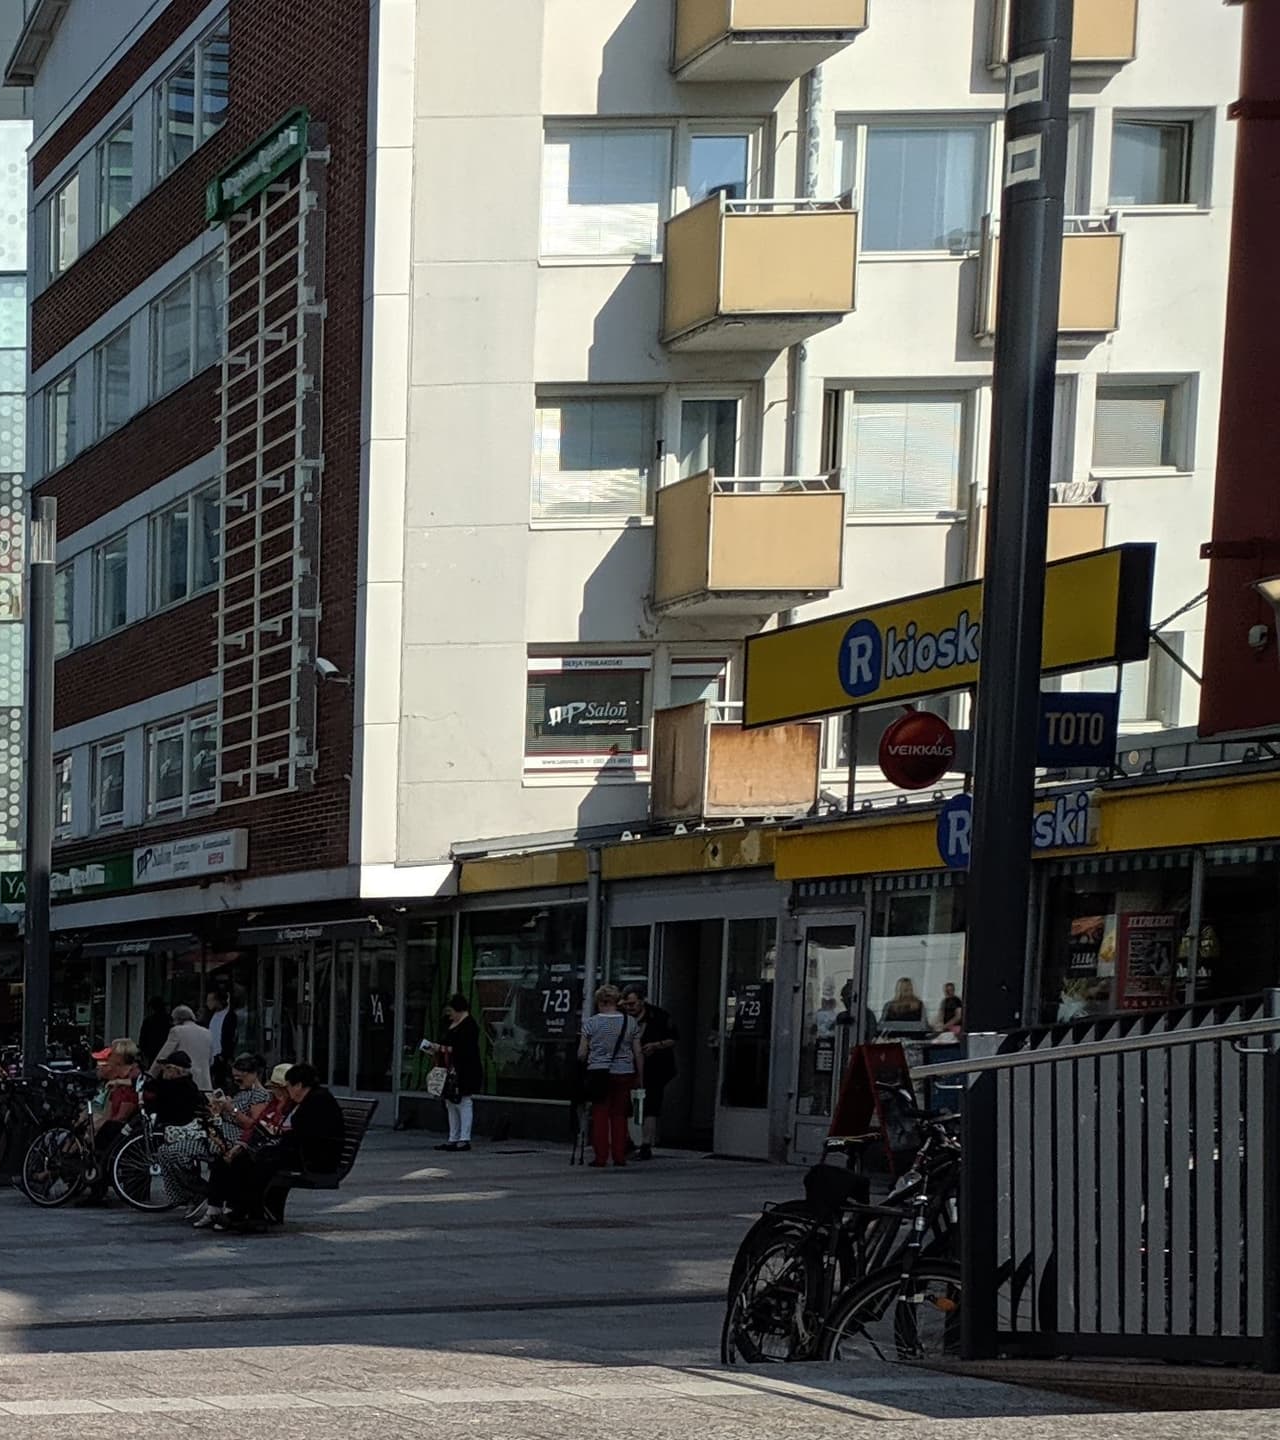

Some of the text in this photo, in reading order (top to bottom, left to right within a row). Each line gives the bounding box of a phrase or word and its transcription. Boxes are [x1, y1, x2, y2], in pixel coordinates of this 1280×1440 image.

[849, 612, 980, 685] R kiosk
[585, 702, 628, 718] Salon
[1045, 712, 1104, 746] TOTO
[888, 742, 953, 757] VEIKKAUS
[947, 810, 971, 855] R
[542, 989, 571, 1013] 7-23
[740, 1000, 761, 1016] 7-23
